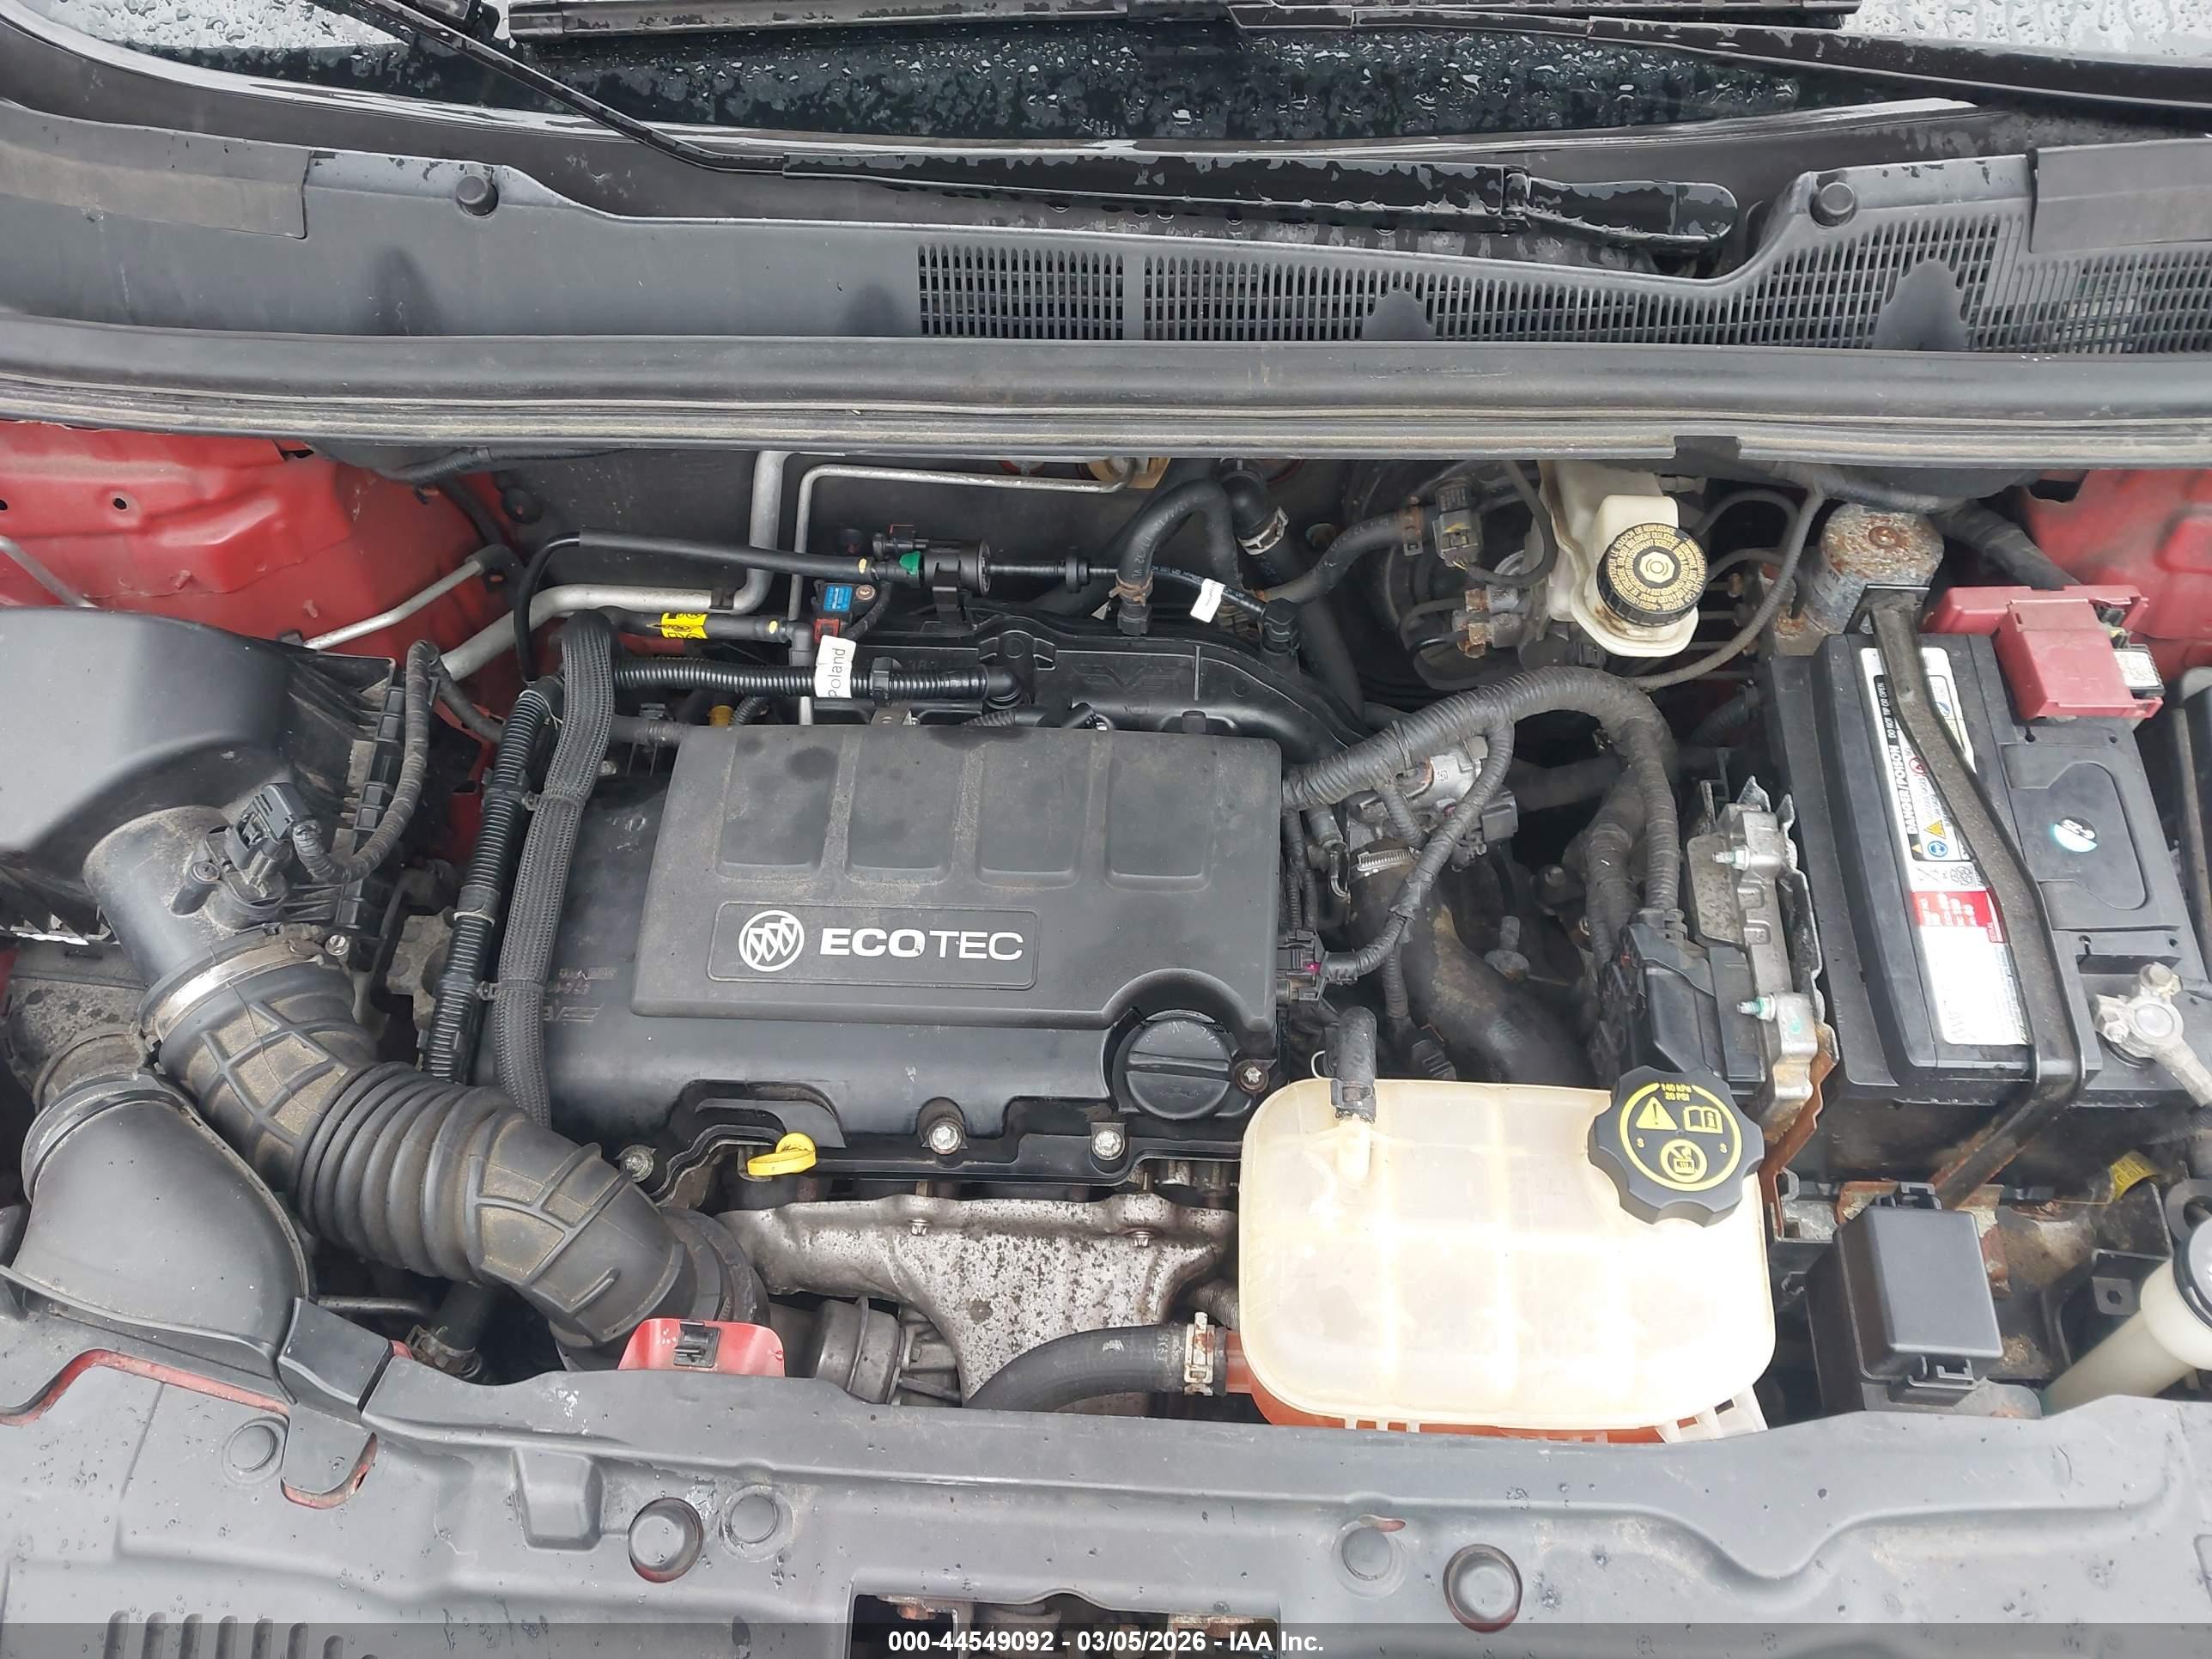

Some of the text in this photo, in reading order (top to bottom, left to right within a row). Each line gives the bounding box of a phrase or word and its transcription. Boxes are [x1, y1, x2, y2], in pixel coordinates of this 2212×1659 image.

[827, 647, 846, 697] Poland
[819, 927, 1024, 961] ECOTEC
[1661, 1083, 1675, 1091] 140
[1676, 1093, 1690, 1102] PSI
